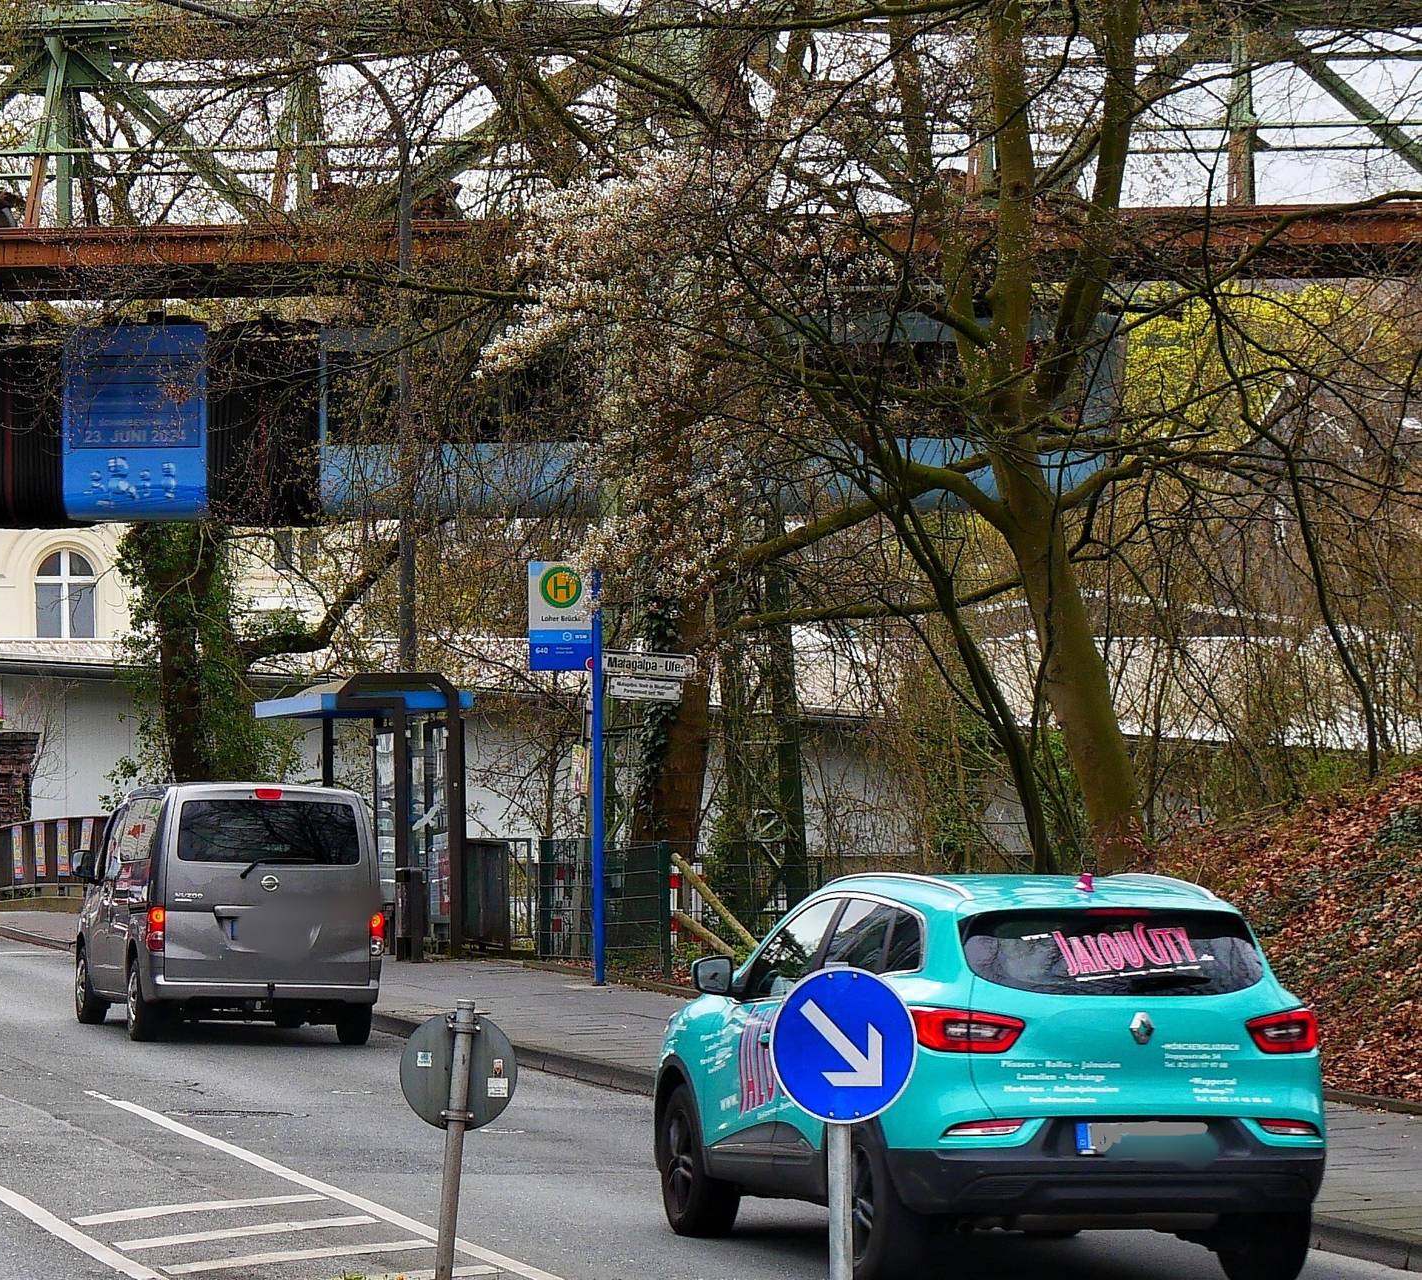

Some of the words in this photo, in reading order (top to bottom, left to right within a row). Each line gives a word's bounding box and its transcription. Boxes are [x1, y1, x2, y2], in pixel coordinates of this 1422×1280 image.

[110, 430, 147, 442] JUNI
[553, 576, 571, 599] H
[607, 656, 658, 672] Matagalpa
